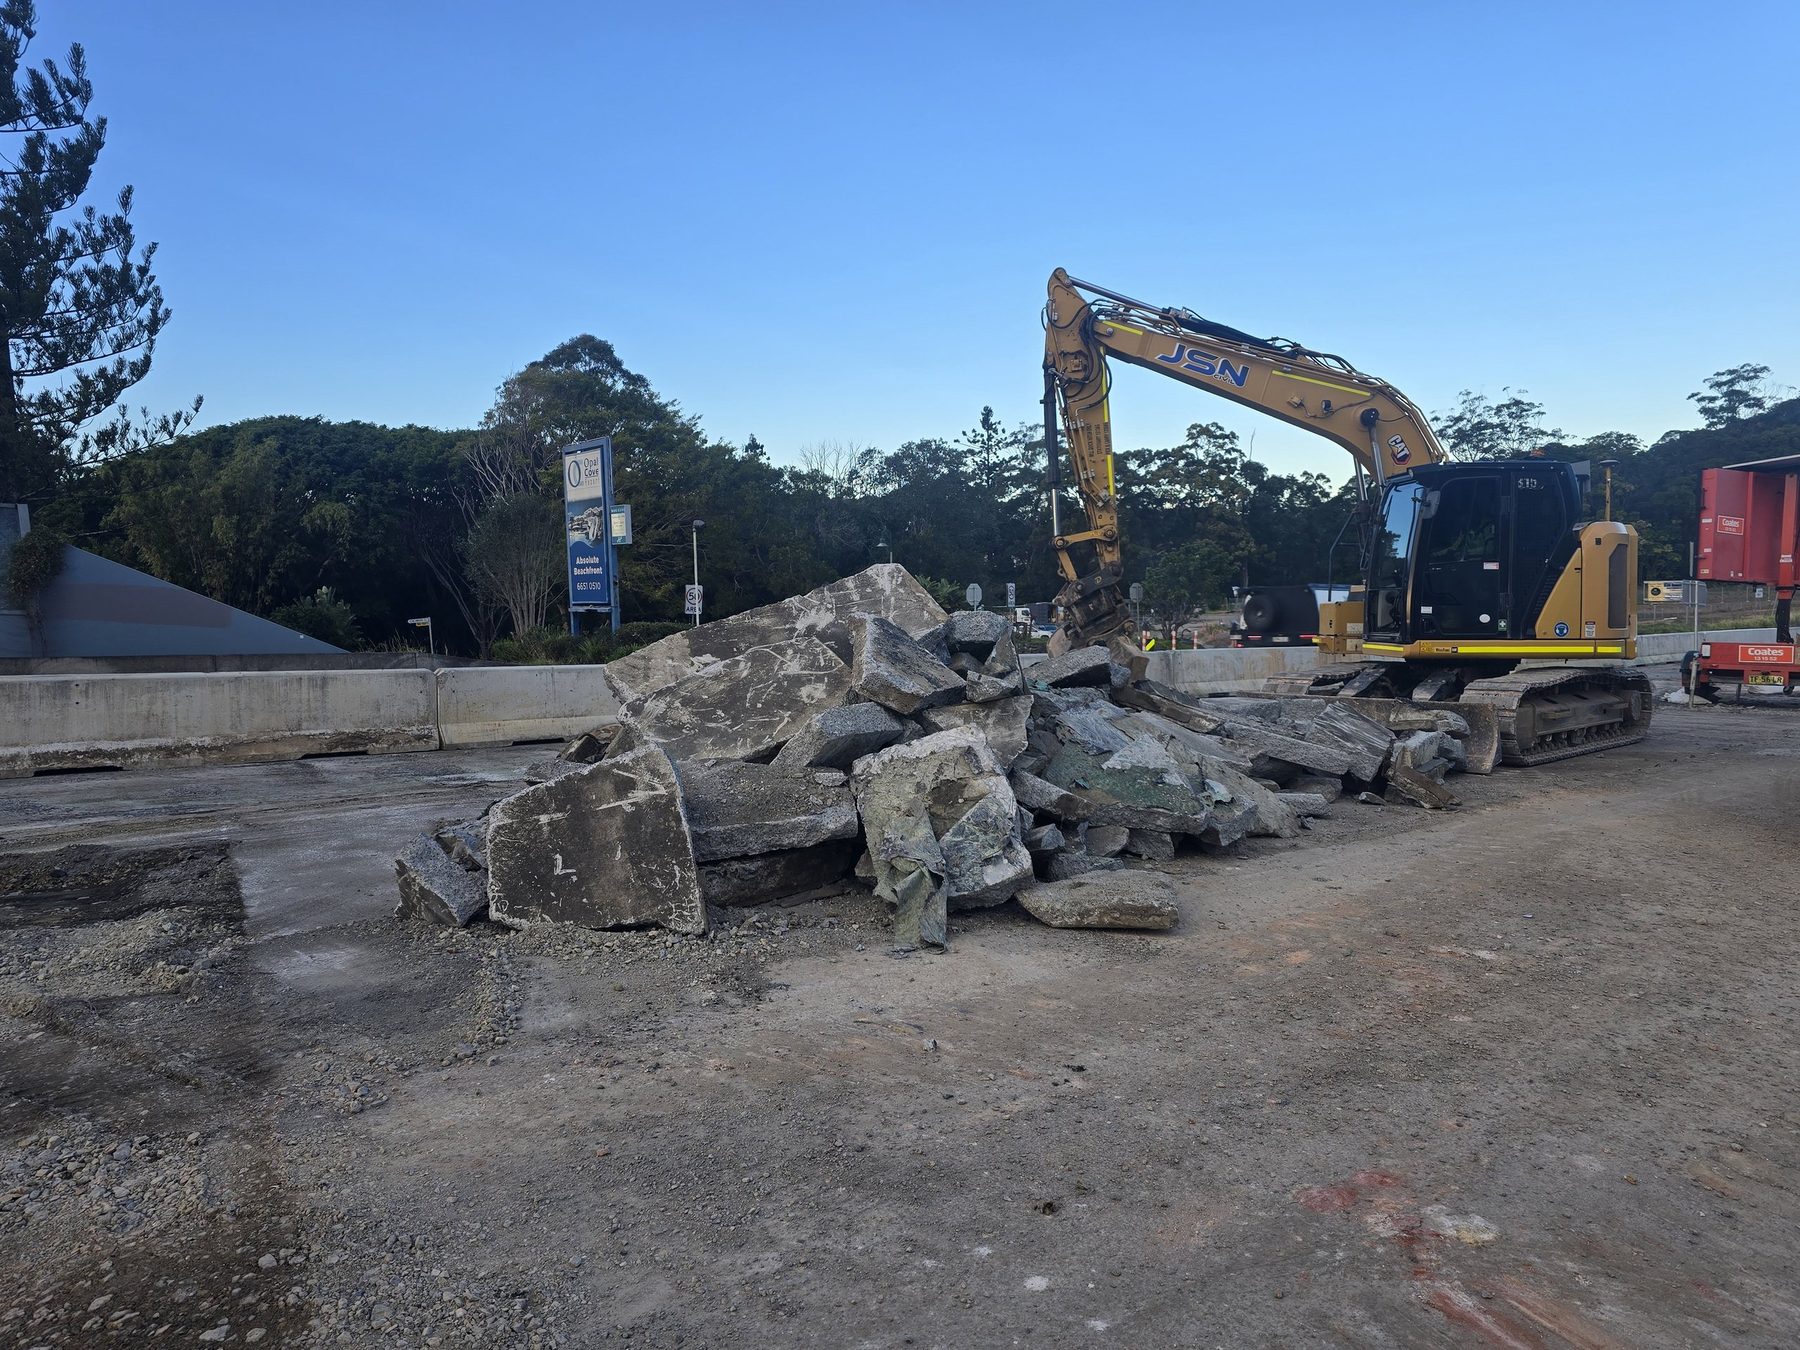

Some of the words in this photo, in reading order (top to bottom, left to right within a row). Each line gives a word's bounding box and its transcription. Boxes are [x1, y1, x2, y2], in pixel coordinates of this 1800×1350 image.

[1155, 343, 1250, 388] JSN
[1388, 434, 1410, 460] CAT
[584, 457, 599, 469] Opal
[584, 468, 599, 477] Cove
[576, 556, 599, 564] Absolute
[574, 567, 602, 575] Beachfront
[1748, 647, 1784, 656] Coates
